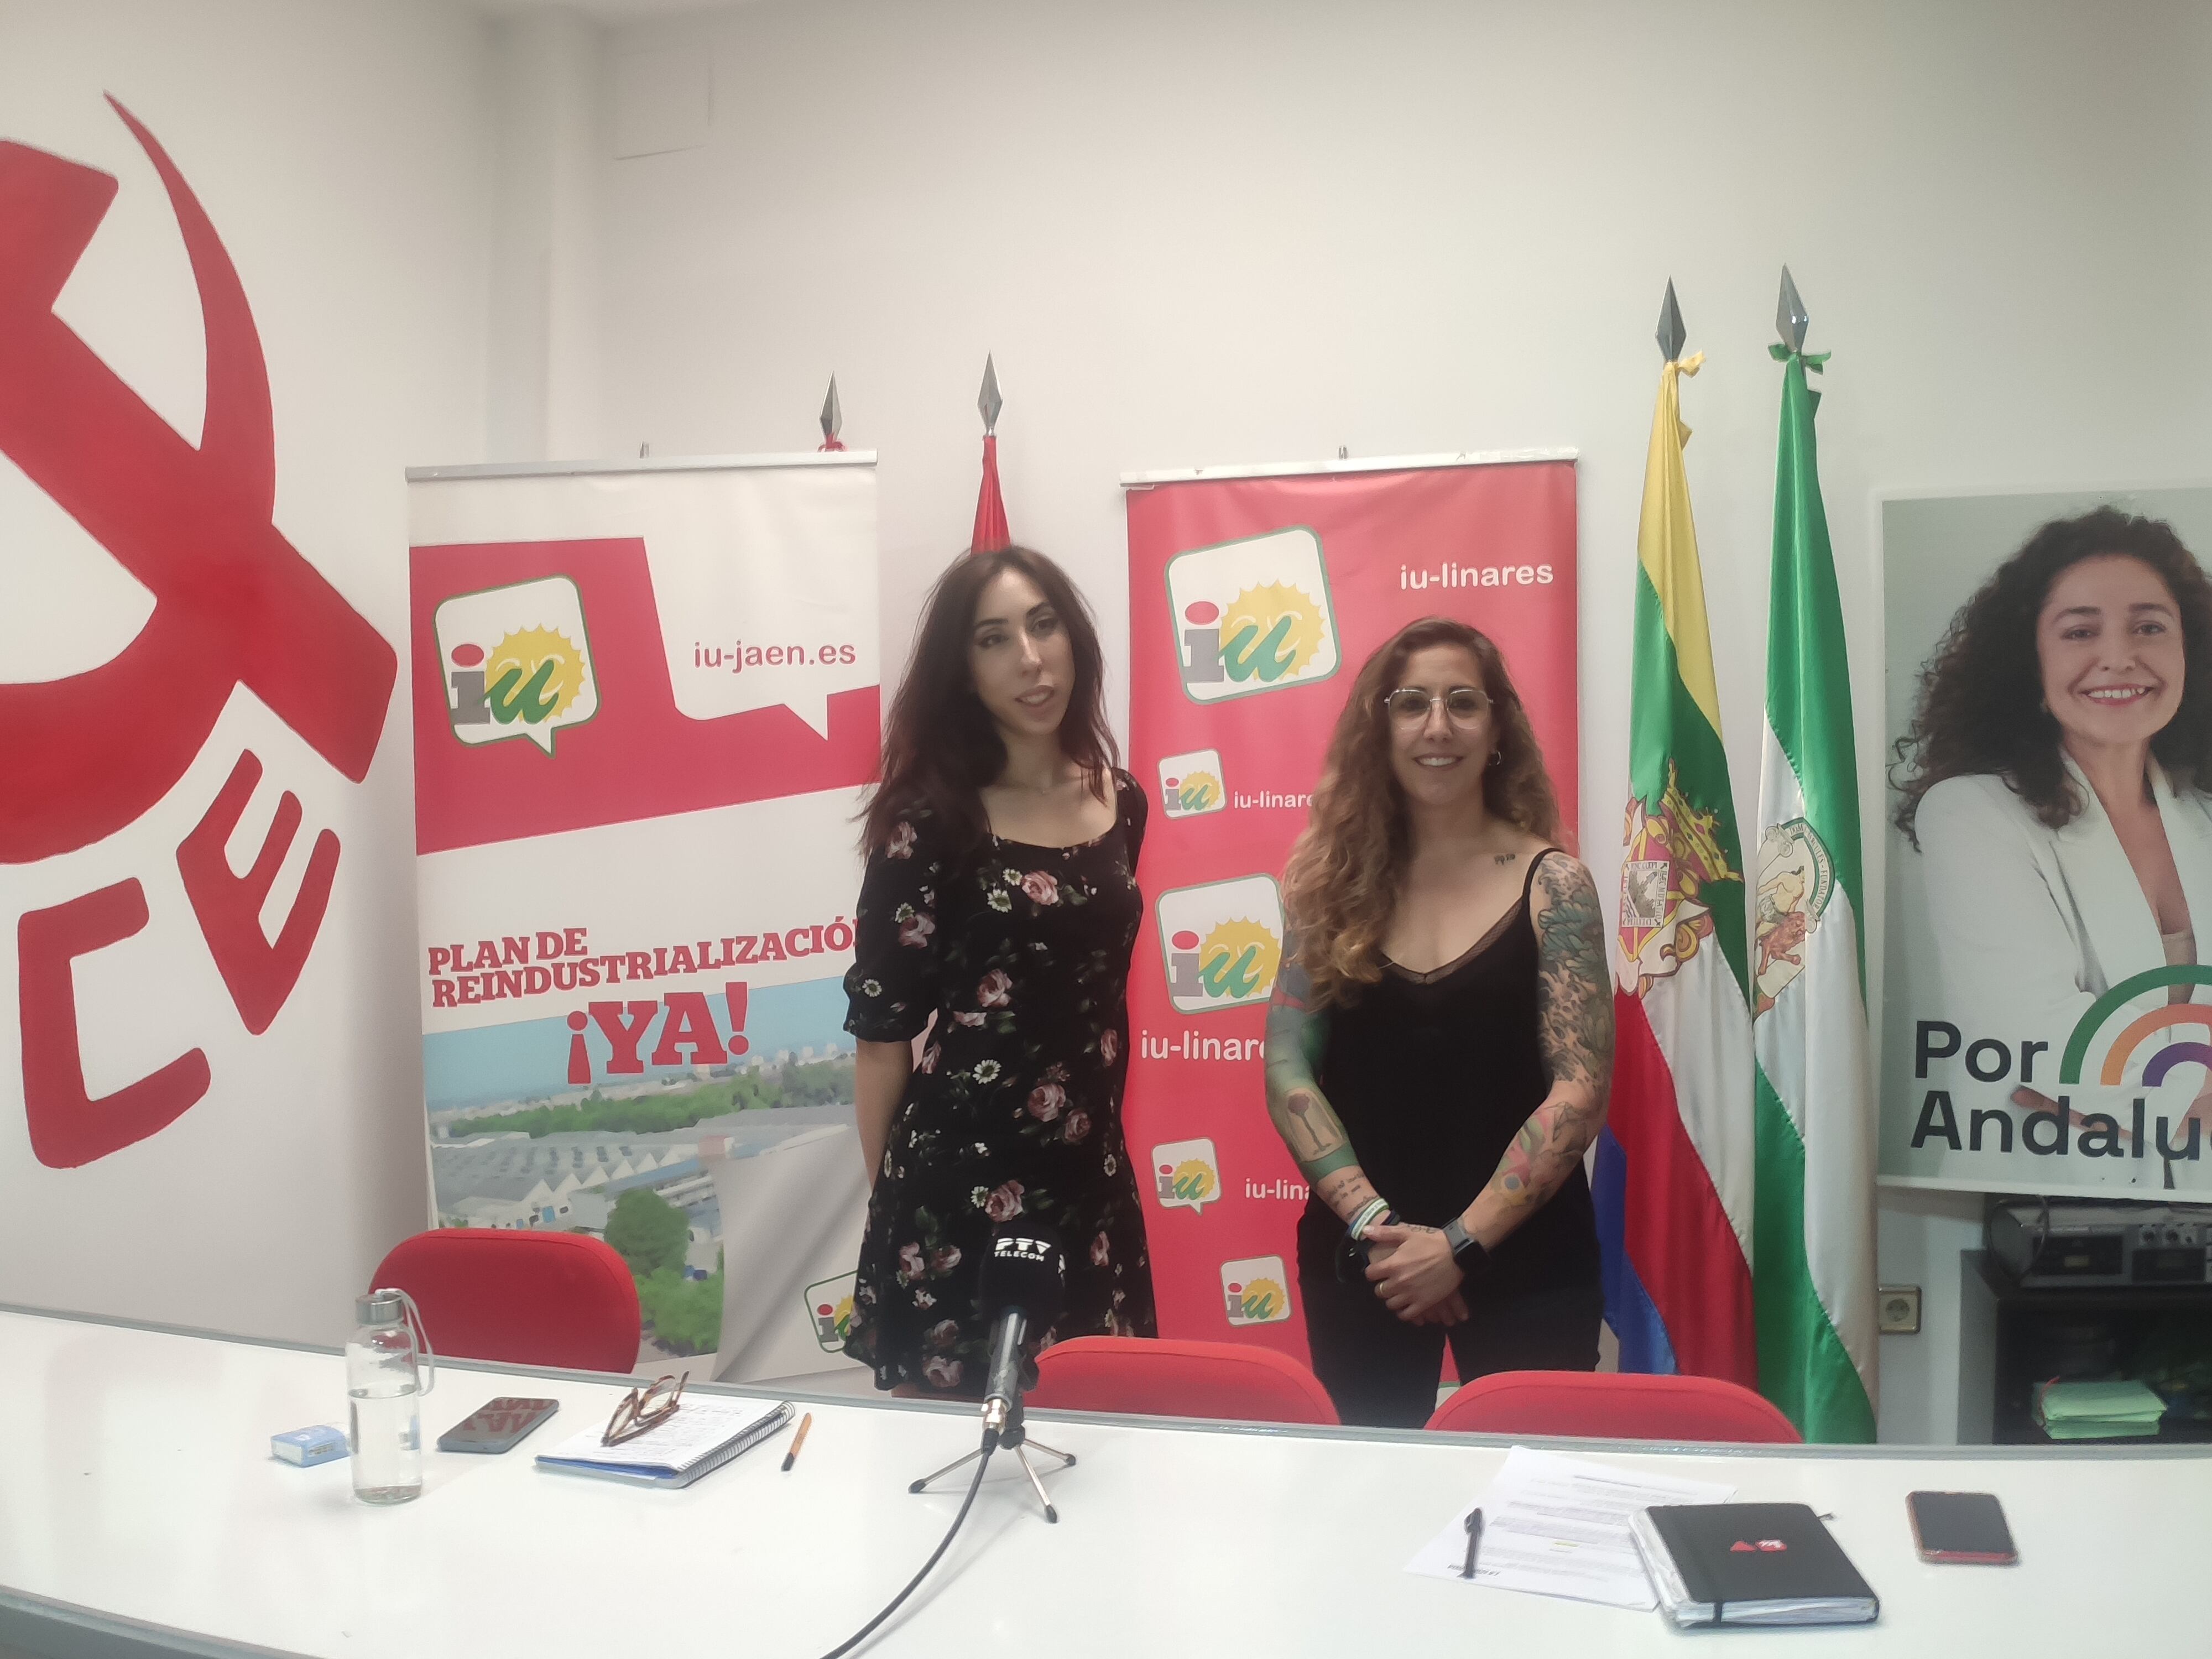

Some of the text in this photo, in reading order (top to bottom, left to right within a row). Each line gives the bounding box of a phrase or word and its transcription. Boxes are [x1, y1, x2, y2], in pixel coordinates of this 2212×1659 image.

[1401, 561, 1553, 590] iu-linares
[695, 639, 856, 674] iu-jaen.es
[1183, 601, 1297, 684] iu
[451, 644, 559, 725] iu
[428, 928, 588, 975] PLAN DE
[432, 916, 858, 1008] REINDUSTRIALIZACIÓ
[1171, 930, 1261, 999] iu
[567, 982, 749, 1084] ¡YA!
[1142, 1030, 1264, 1061] iu-linar
[1914, 1020, 2048, 1083] Por
[1910, 1090, 2212, 1161] Andalu
[994, 1250, 1045, 1262] TELECOM
